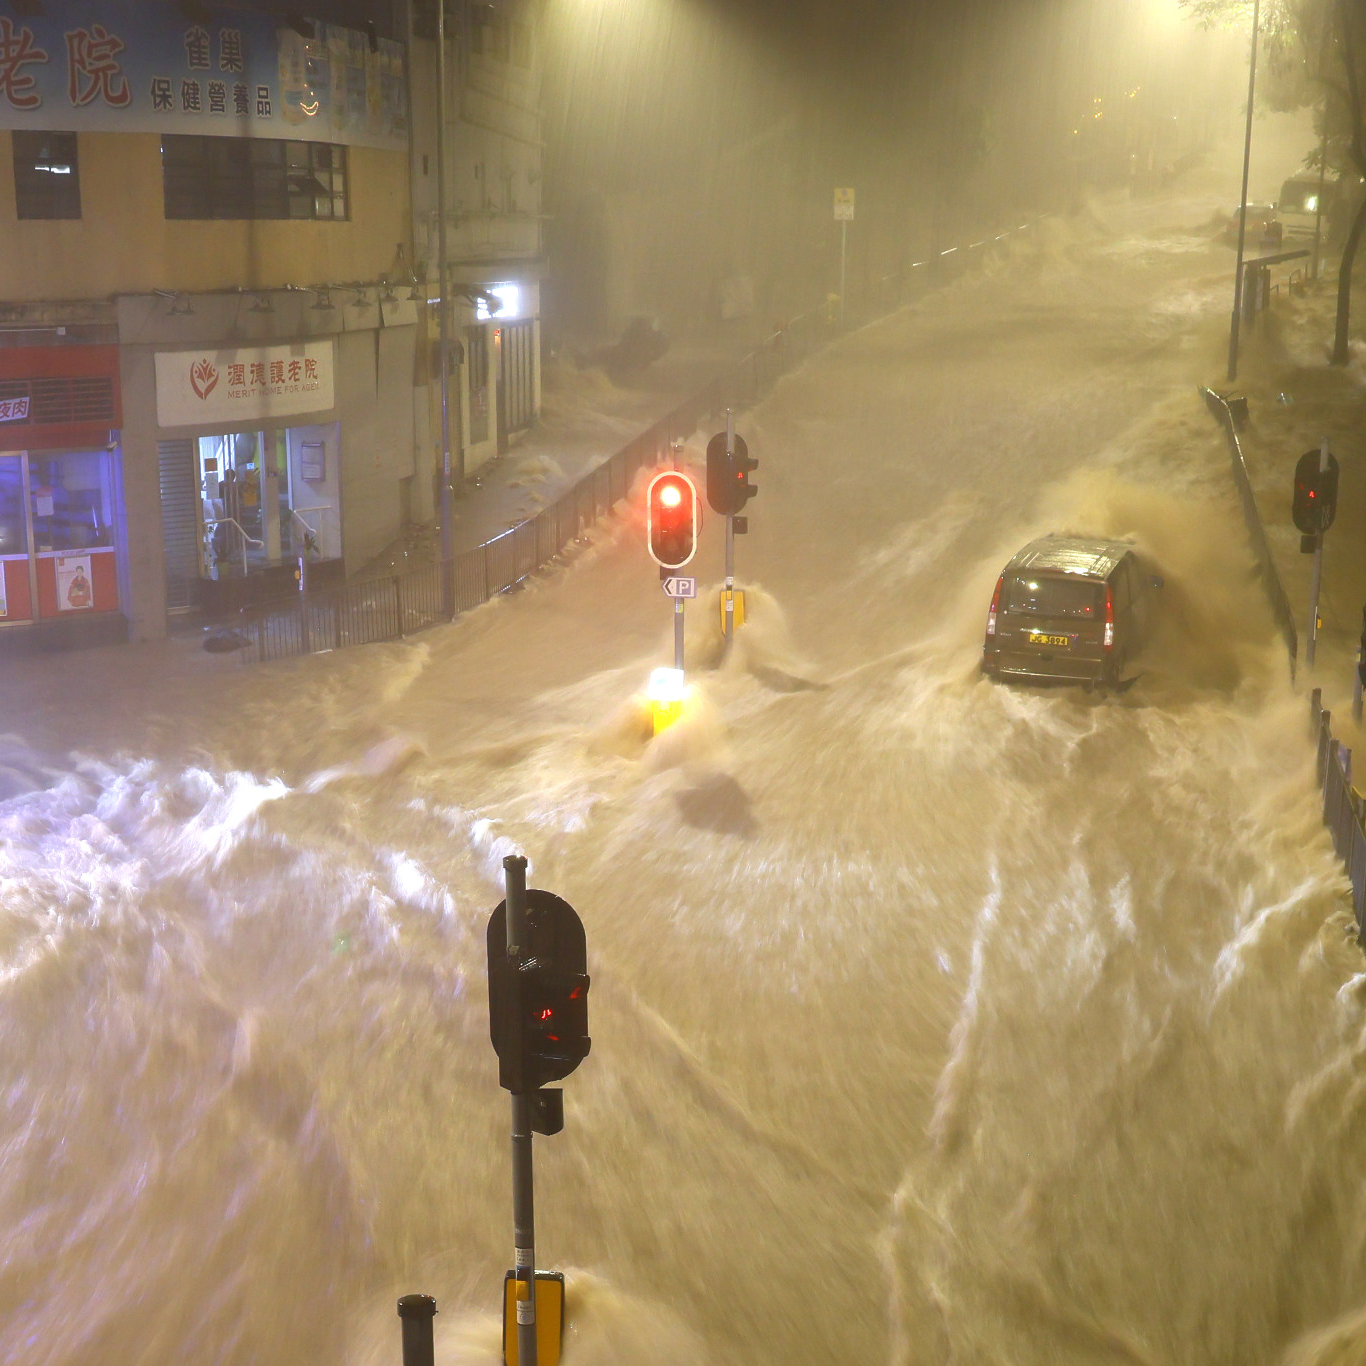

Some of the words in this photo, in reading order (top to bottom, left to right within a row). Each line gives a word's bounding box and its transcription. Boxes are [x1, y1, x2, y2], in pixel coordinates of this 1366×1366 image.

[186, 26, 242, 71] 雀巢
[150, 77, 272, 118] 保健營養品
[227, 358, 319, 387] 潤德護老院
[227, 388, 257, 399] MERIT
[259, 385, 282, 396] HOME
[285, 383, 299, 393] FOR
[679, 580, 690, 594] P
